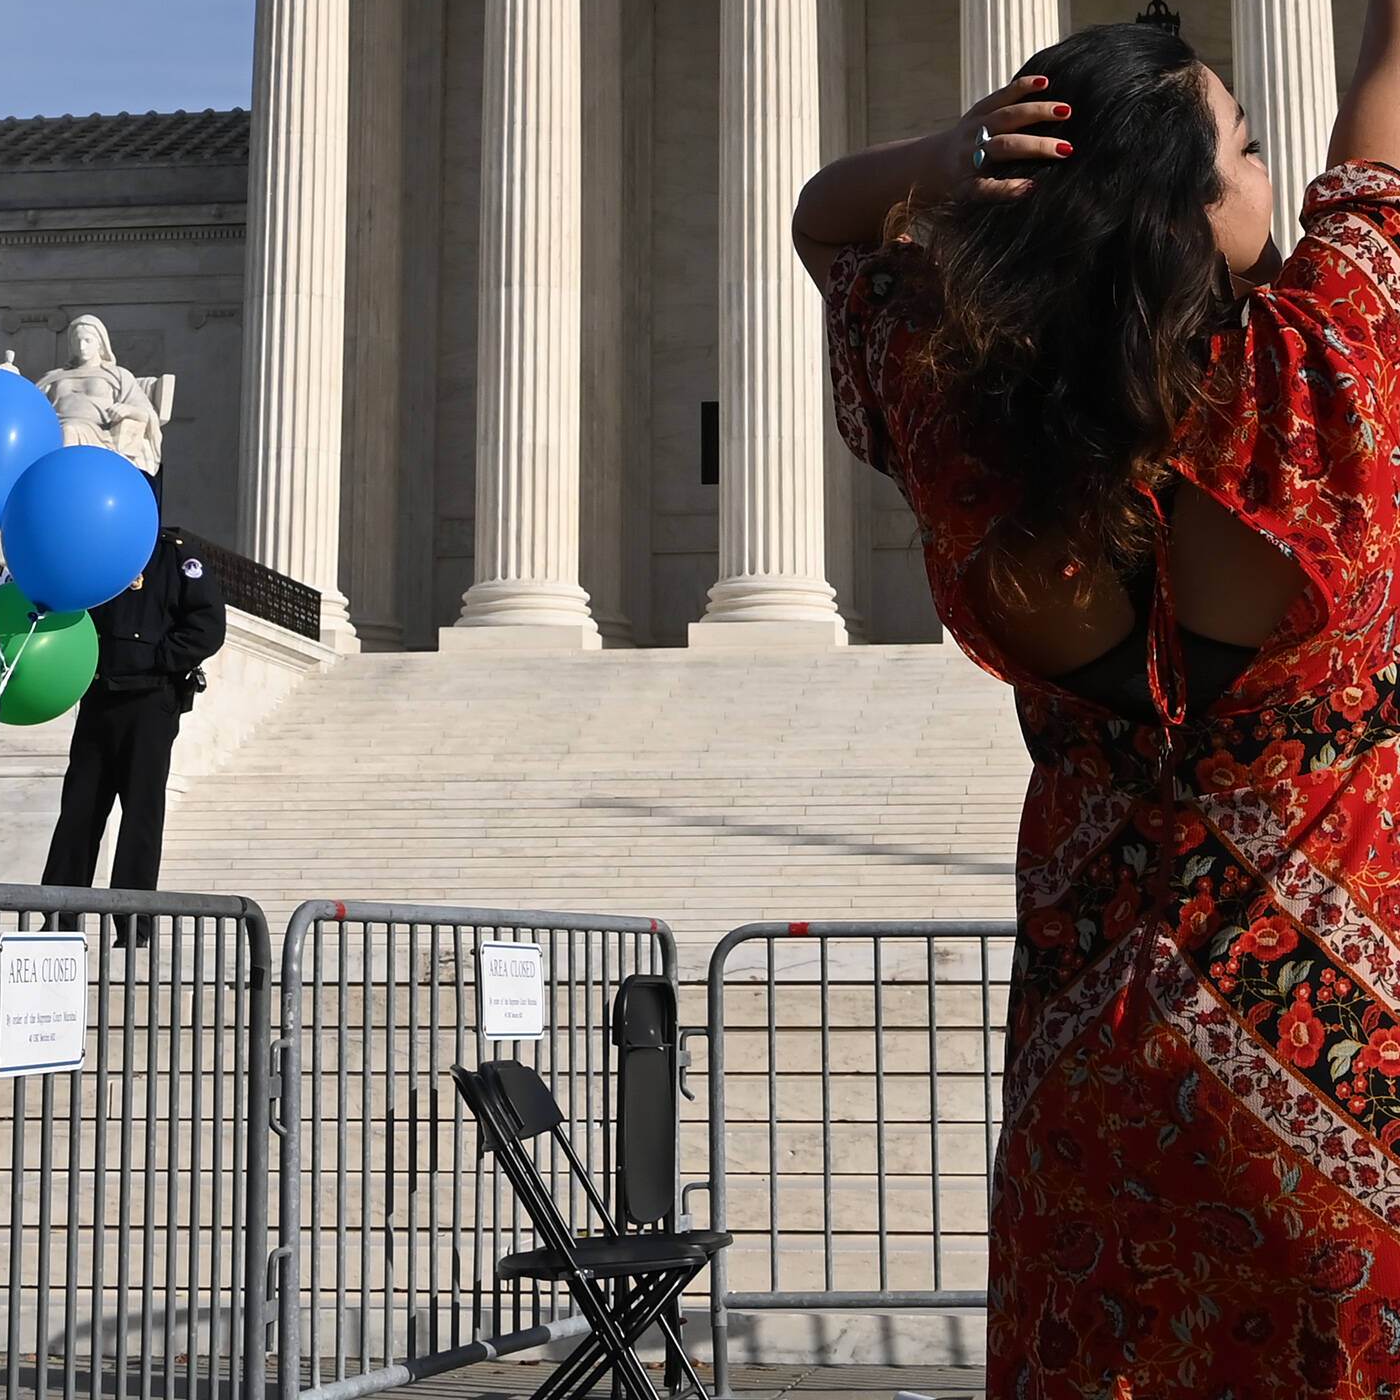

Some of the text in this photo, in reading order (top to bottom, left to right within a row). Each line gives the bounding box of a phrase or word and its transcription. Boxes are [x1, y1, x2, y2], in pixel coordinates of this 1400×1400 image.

[8, 958, 77, 983] AREA CLOSED
[489, 959, 536, 978] AREA CLOSED
